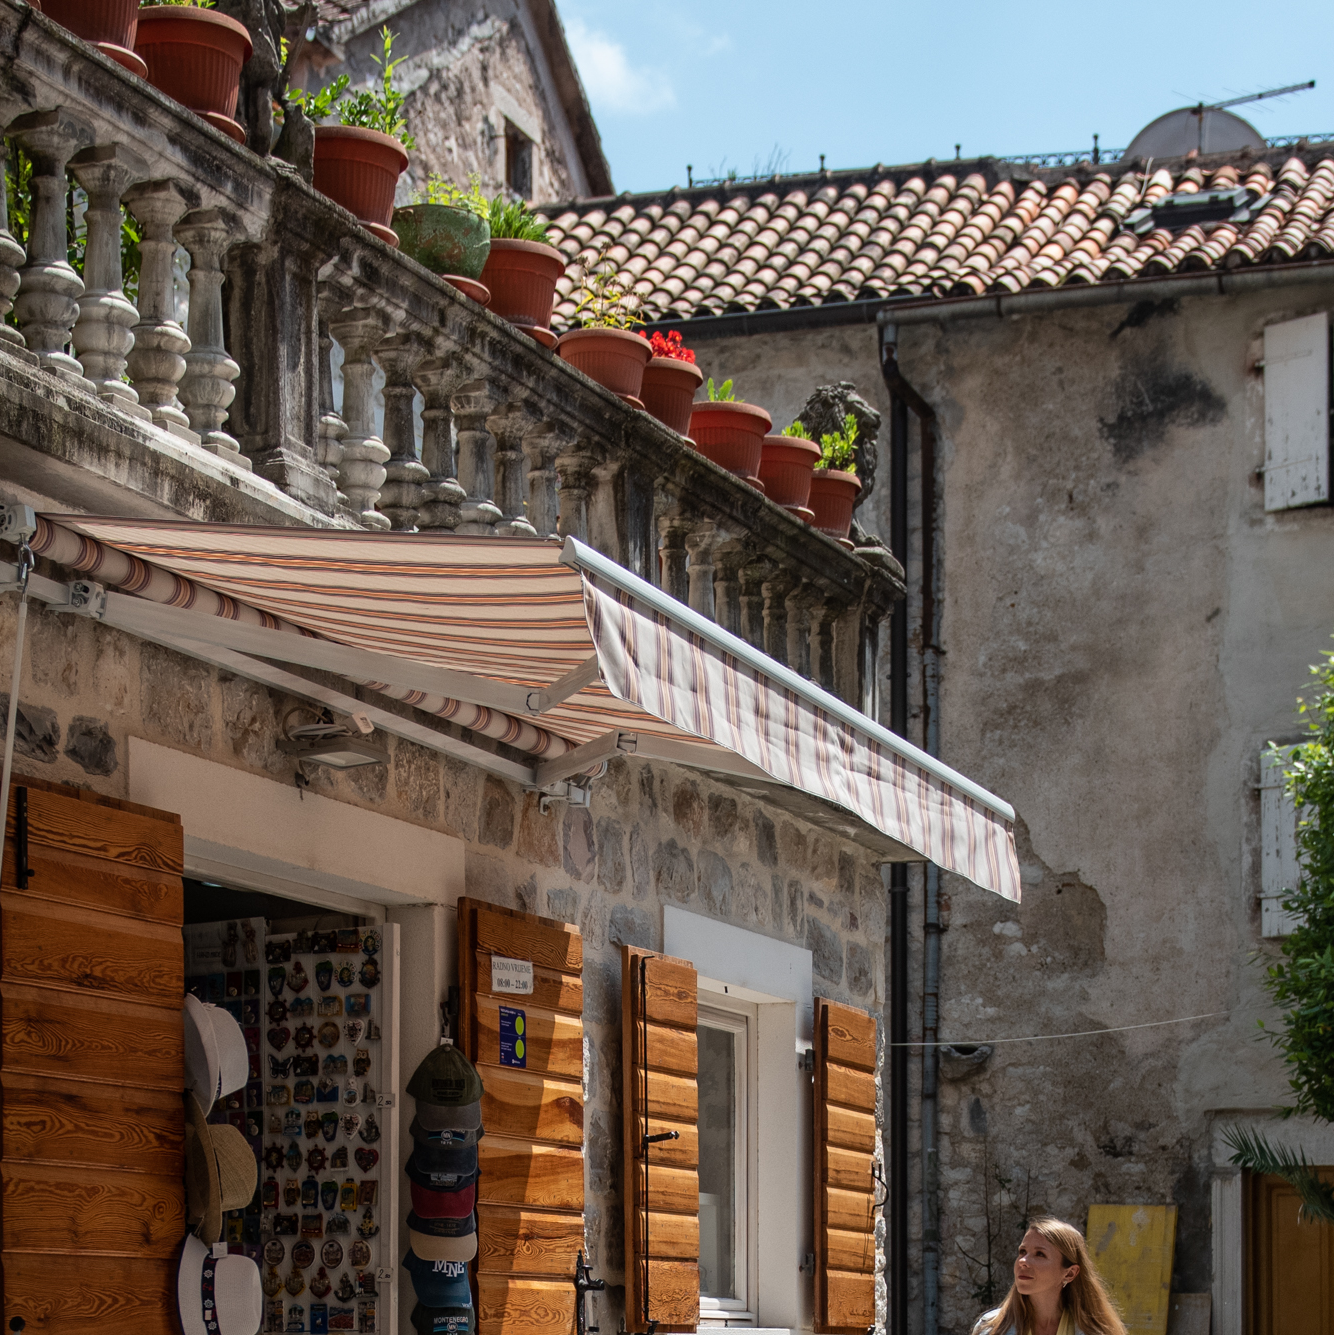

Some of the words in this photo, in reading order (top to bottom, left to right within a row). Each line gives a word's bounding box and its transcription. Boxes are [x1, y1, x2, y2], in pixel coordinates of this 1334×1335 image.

[492, 961, 510, 971] RADNO
[511, 963, 532, 974] VRIJEME
[432, 1260, 465, 1278] MNE
[433, 1316, 468, 1324] MONTENEGRO
